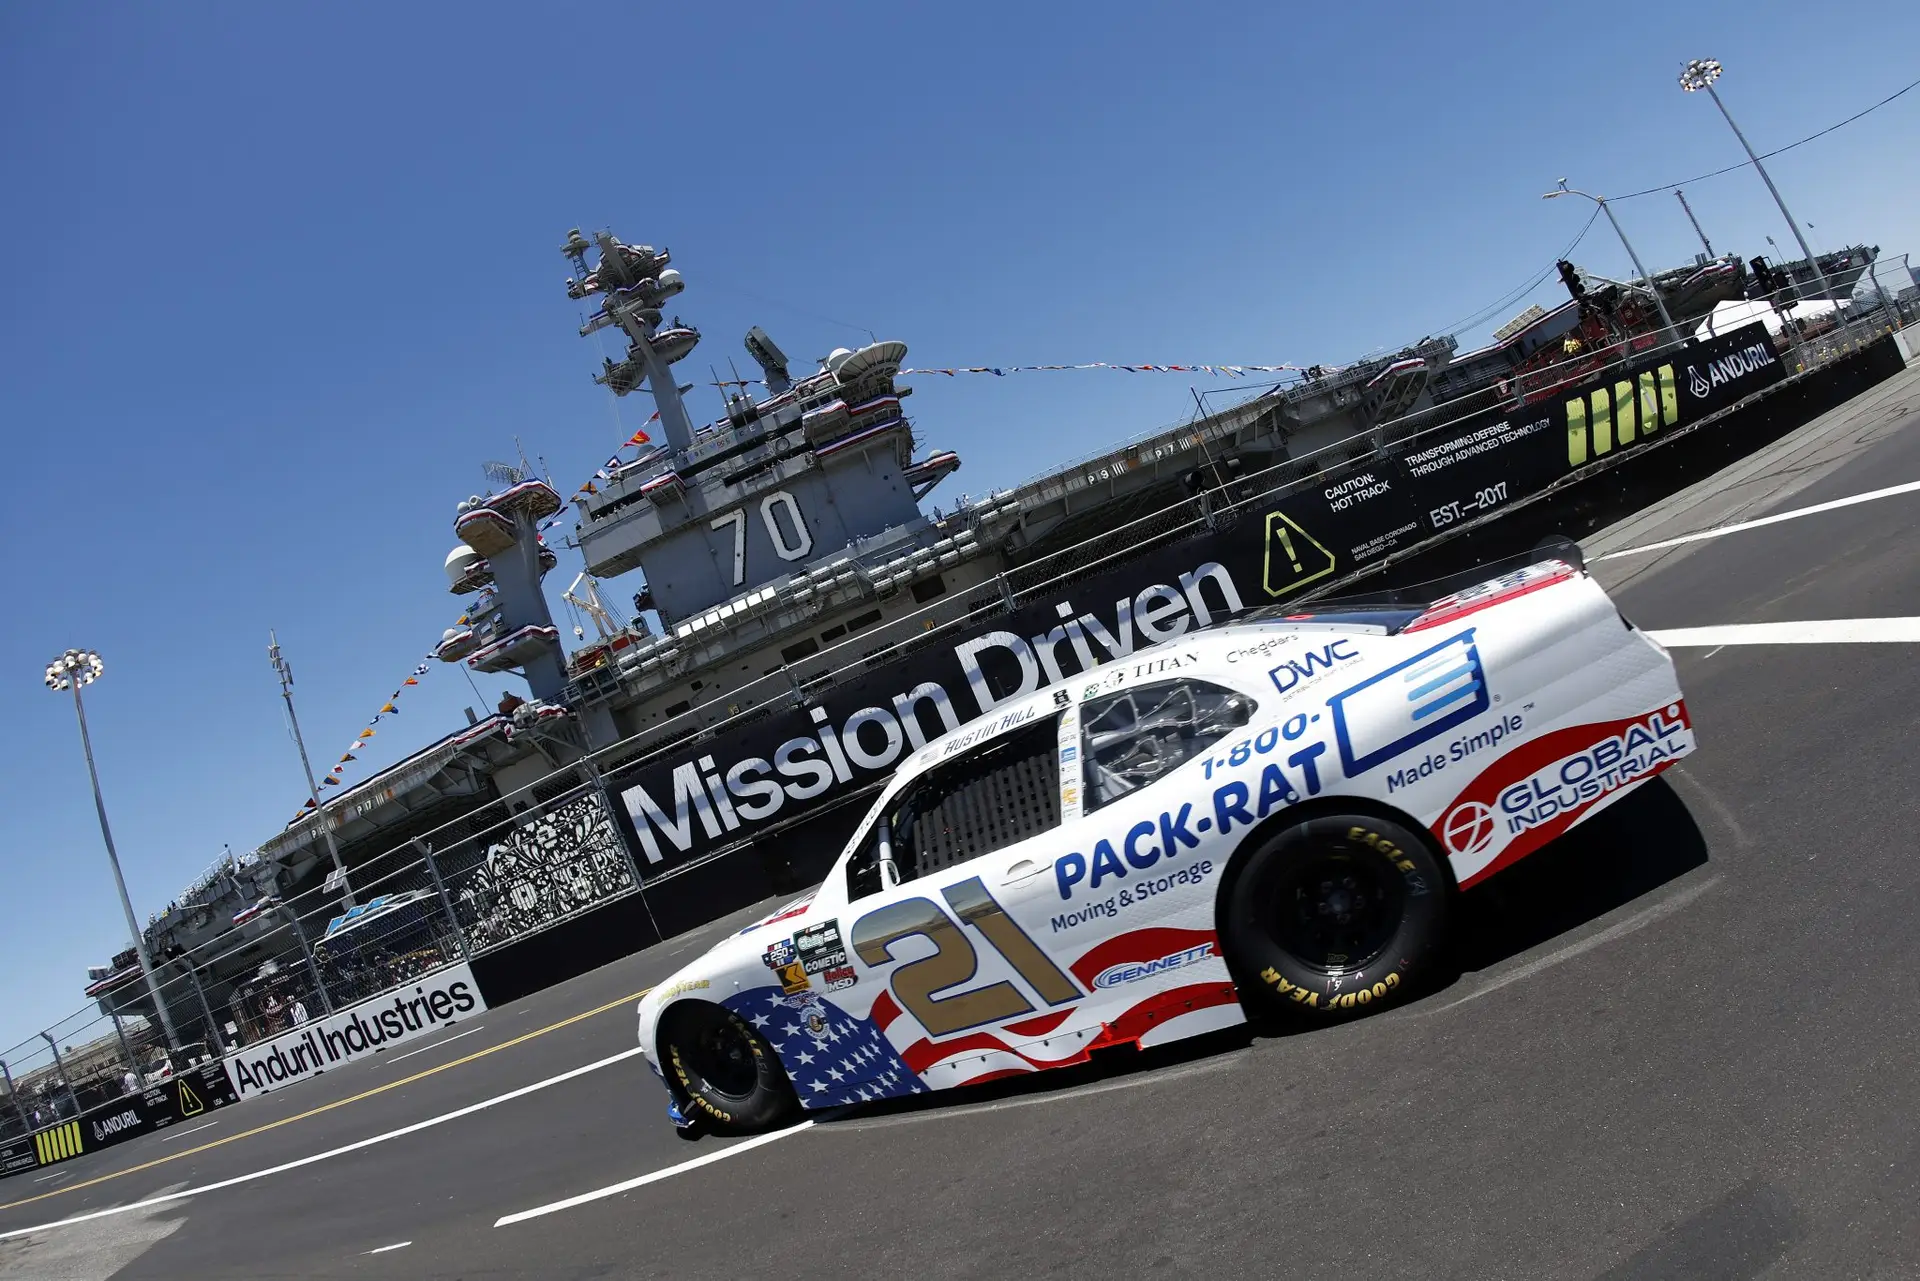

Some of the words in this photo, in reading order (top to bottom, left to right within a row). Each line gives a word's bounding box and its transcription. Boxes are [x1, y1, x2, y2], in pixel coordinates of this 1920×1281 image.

[1707, 344, 1775, 388] ANDURIL
[1404, 433, 1473, 467] TRANSFORMING
[1472, 421, 1511, 443] DEFENSE
[1410, 455, 1455, 478] THROUGH
[1456, 438, 1500, 463] ADVANCED
[1498, 418, 1550, 445] TECHNOLOGY
[1324, 473, 1376, 500] CAUTION:
[1330, 497, 1352, 513] HOT
[1353, 480, 1392, 506] TRACK
[710, 490, 813, 586] 70
[1351, 541, 1370, 555] NAVAL
[1370, 535, 1385, 548] BASE
[1385, 522, 1417, 542] CORONADO
[1354, 551, 1367, 562] SAN
[1133, 652, 1199, 678] TITAN
[1268, 639, 1360, 694] DWC
[620, 680, 961, 866] Mission
[955, 562, 1245, 713] Driven
[944, 723, 997, 756] AUSTIN
[1000, 705, 1035, 731] HILL
[1201, 713, 1321, 780] 1-800-
[1386, 752, 1447, 793] Made
[1449, 715, 1524, 763] Simple
[1500, 716, 1681, 813] GLOBAL
[1507, 740, 1687, 834] INDUSTRIAL
[1054, 741, 1326, 900] PACK-RAT
[1348, 826, 1416, 873] EAGLE
[1051, 897, 1118, 933] Moving
[1119, 888, 1135, 908] &
[1136, 858, 1213, 901] Storage
[769, 948, 789, 962] 250
[805, 952, 846, 973] COMETIC
[851, 875, 1085, 1037] 21
[1108, 943, 1213, 985] BENNETT
[827, 977, 854, 993] MSD
[234, 1030, 325, 1094] Anduril
[316, 981, 476, 1063] Industries
[103, 1109, 142, 1136] ANDURIL
